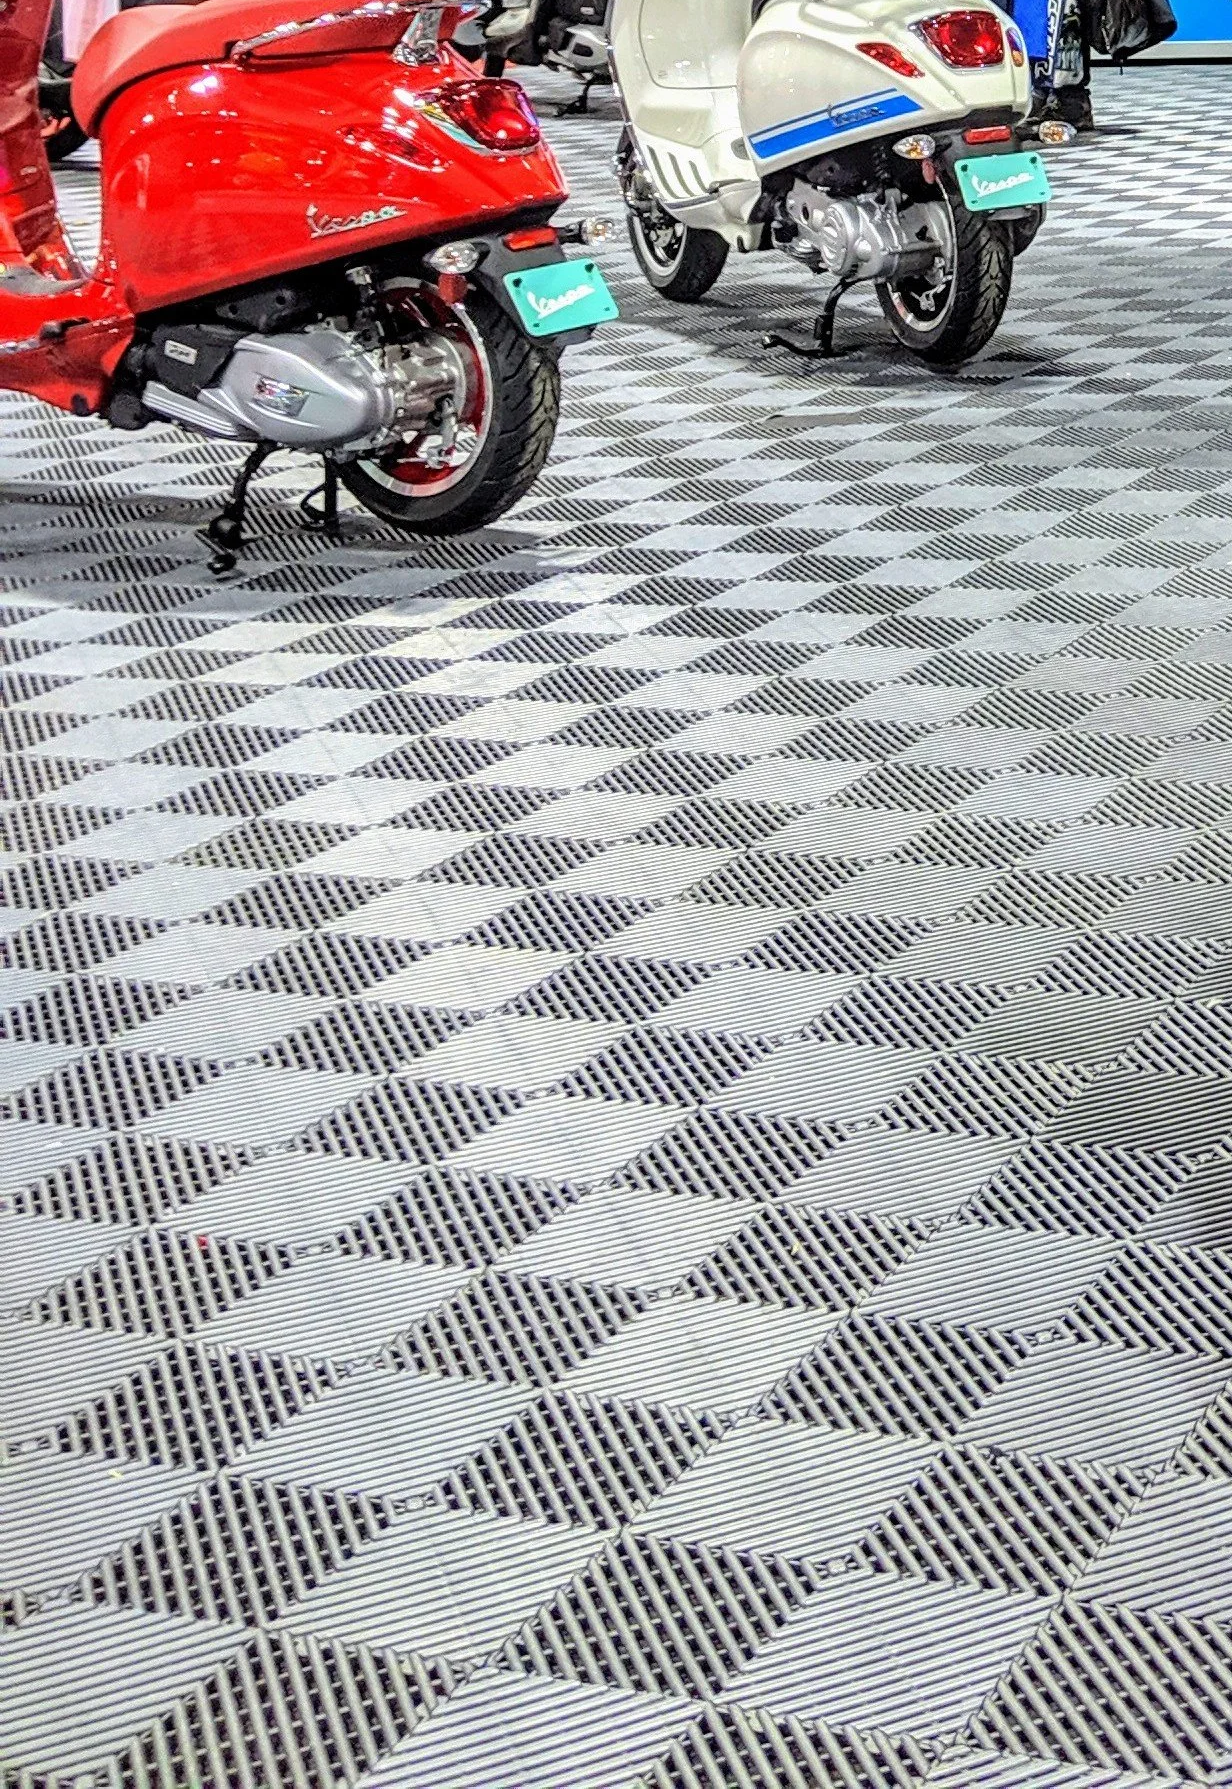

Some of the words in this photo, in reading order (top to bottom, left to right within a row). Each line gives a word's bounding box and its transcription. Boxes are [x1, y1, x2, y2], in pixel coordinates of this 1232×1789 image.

[971, 172, 1035, 198] Vespa
[305, 202, 408, 239] Vespa
[526, 284, 596, 320] Vespa
